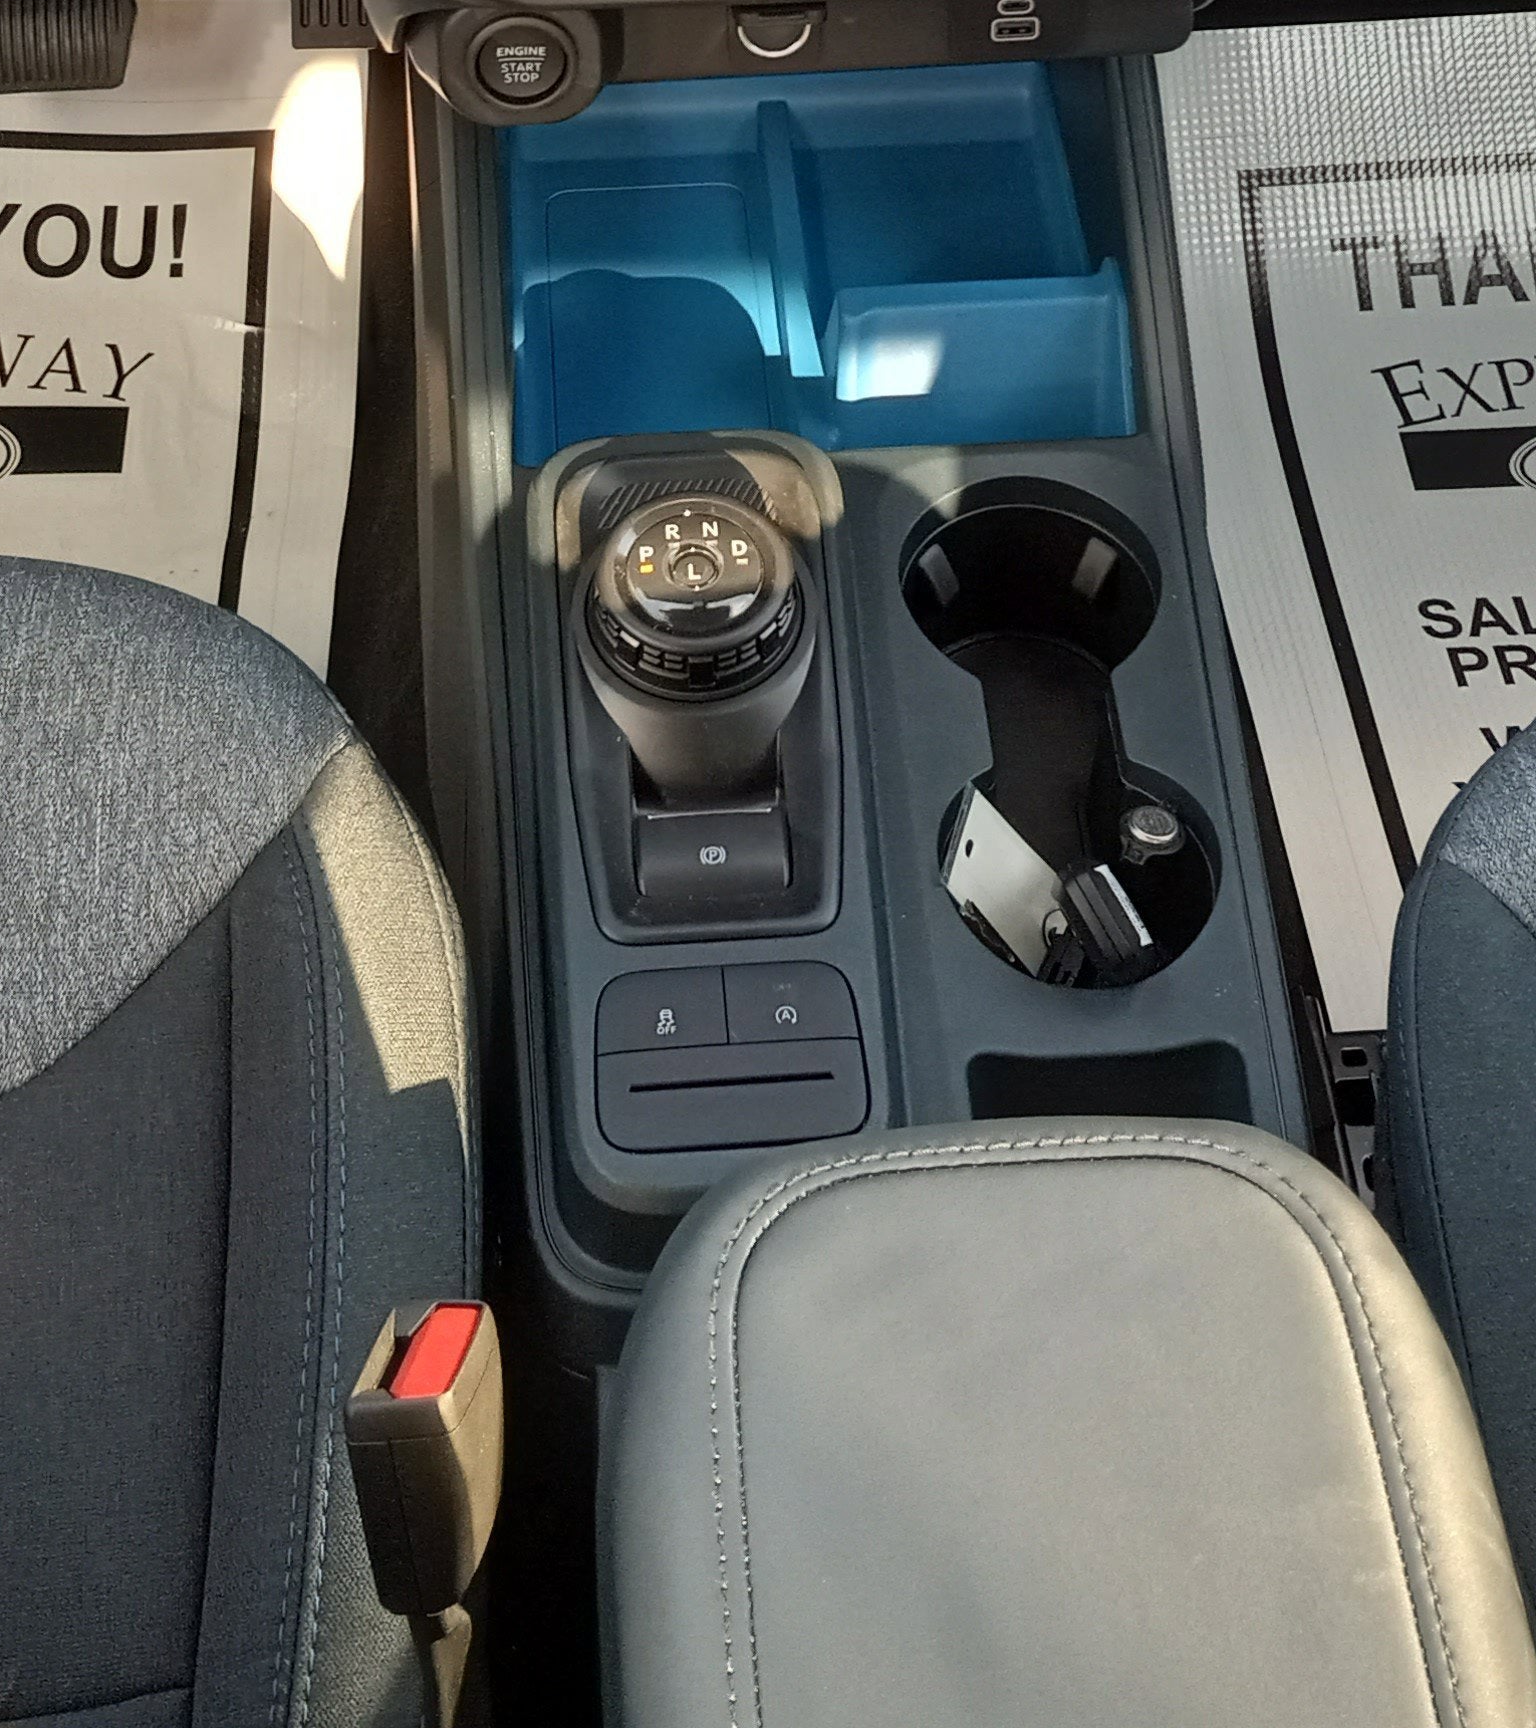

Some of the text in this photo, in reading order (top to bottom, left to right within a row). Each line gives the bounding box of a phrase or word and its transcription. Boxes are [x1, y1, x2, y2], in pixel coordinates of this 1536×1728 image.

[495, 45, 547, 58] ENGINE
[500, 62, 542, 75] START
[503, 73, 540, 85] STOP
[665, 524, 681, 540] R
[702, 520, 719, 538] N
[639, 546, 654, 563] P
[731, 540, 748, 557] D
[687, 563, 701, 580] L
[656, 1025, 677, 1035] OFF
